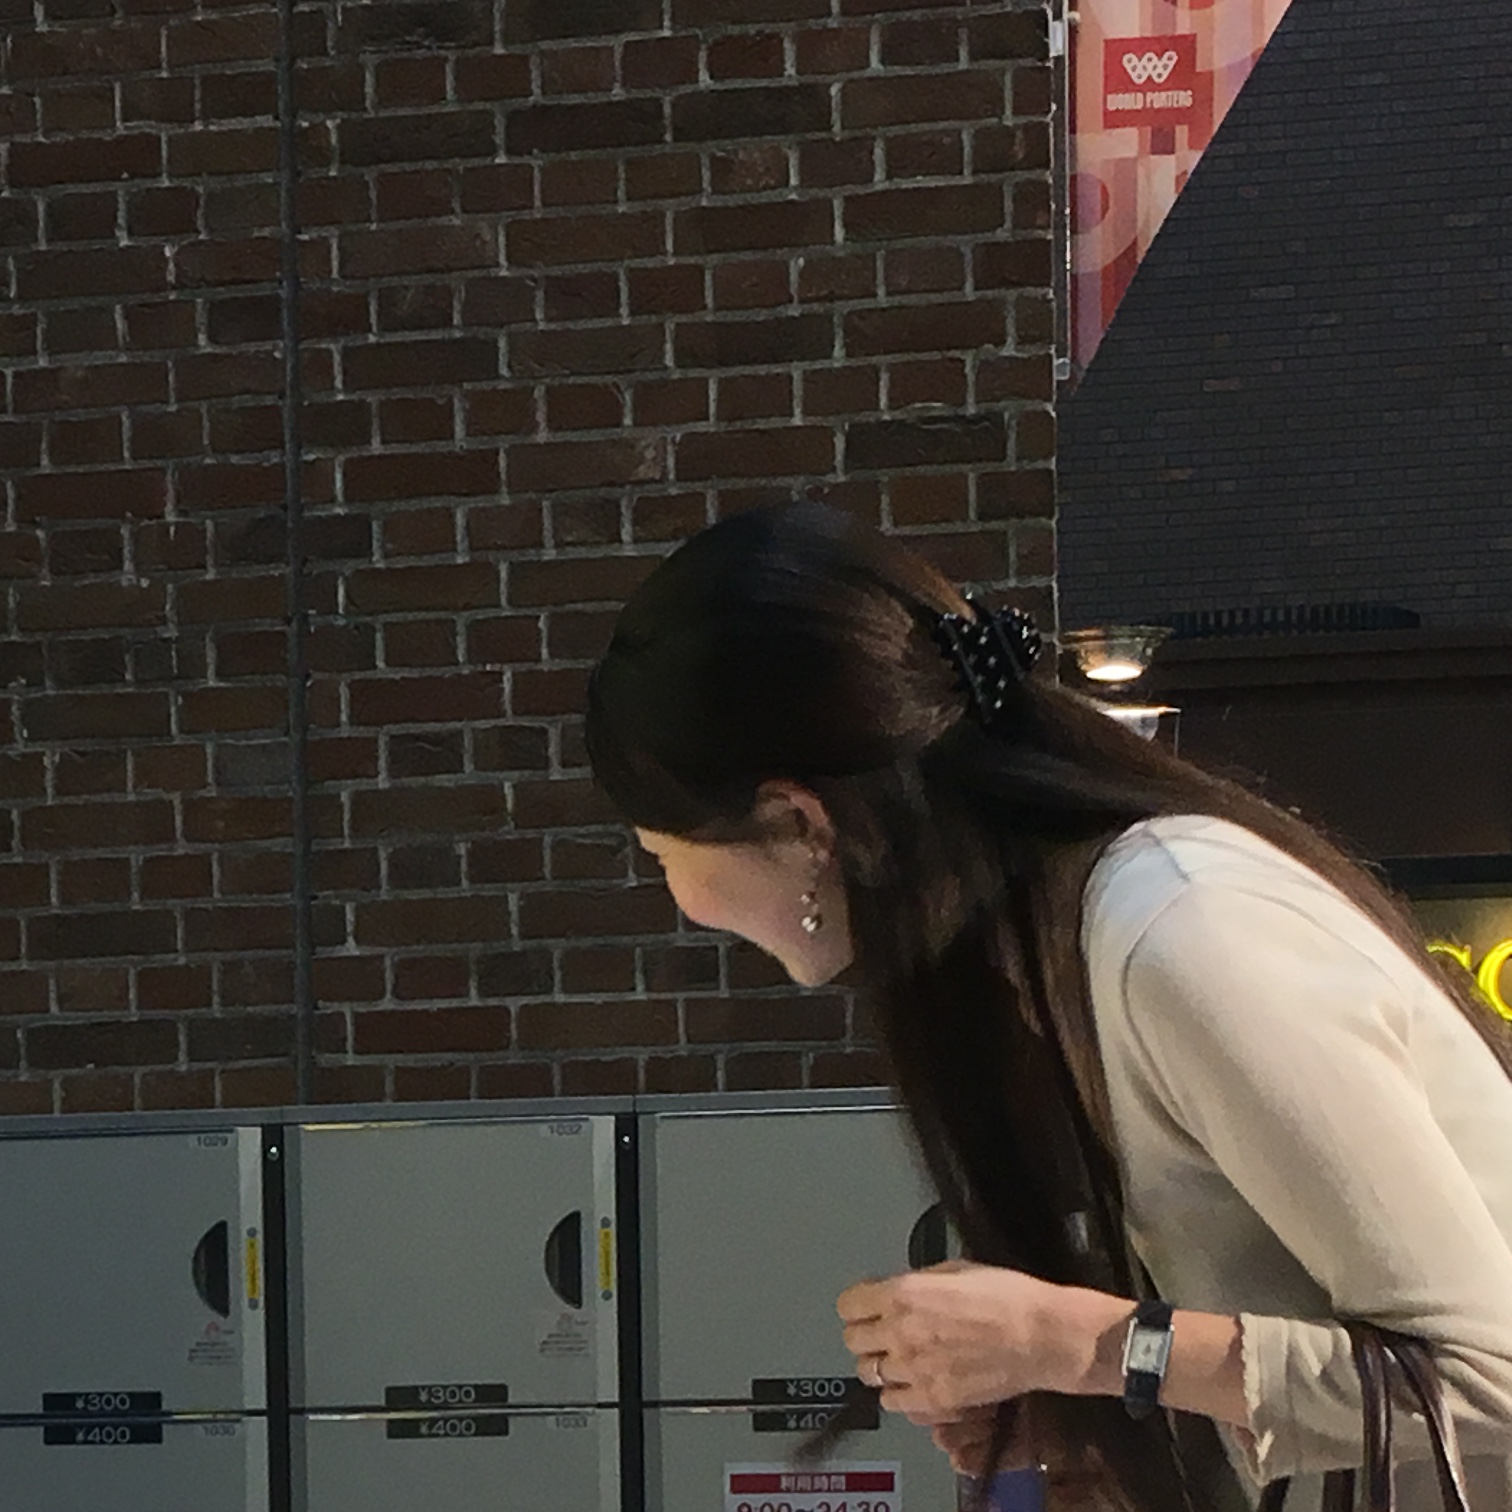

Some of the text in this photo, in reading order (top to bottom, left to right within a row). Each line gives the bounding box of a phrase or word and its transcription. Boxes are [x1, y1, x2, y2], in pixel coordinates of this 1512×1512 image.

[418, 1386, 476, 1403] ¥300
[786, 1380, 846, 1397] ¥300
[75, 1394, 131, 1410] ¥300
[75, 1427, 131, 1443] ¥400
[419, 1419, 476, 1436] ¥400
